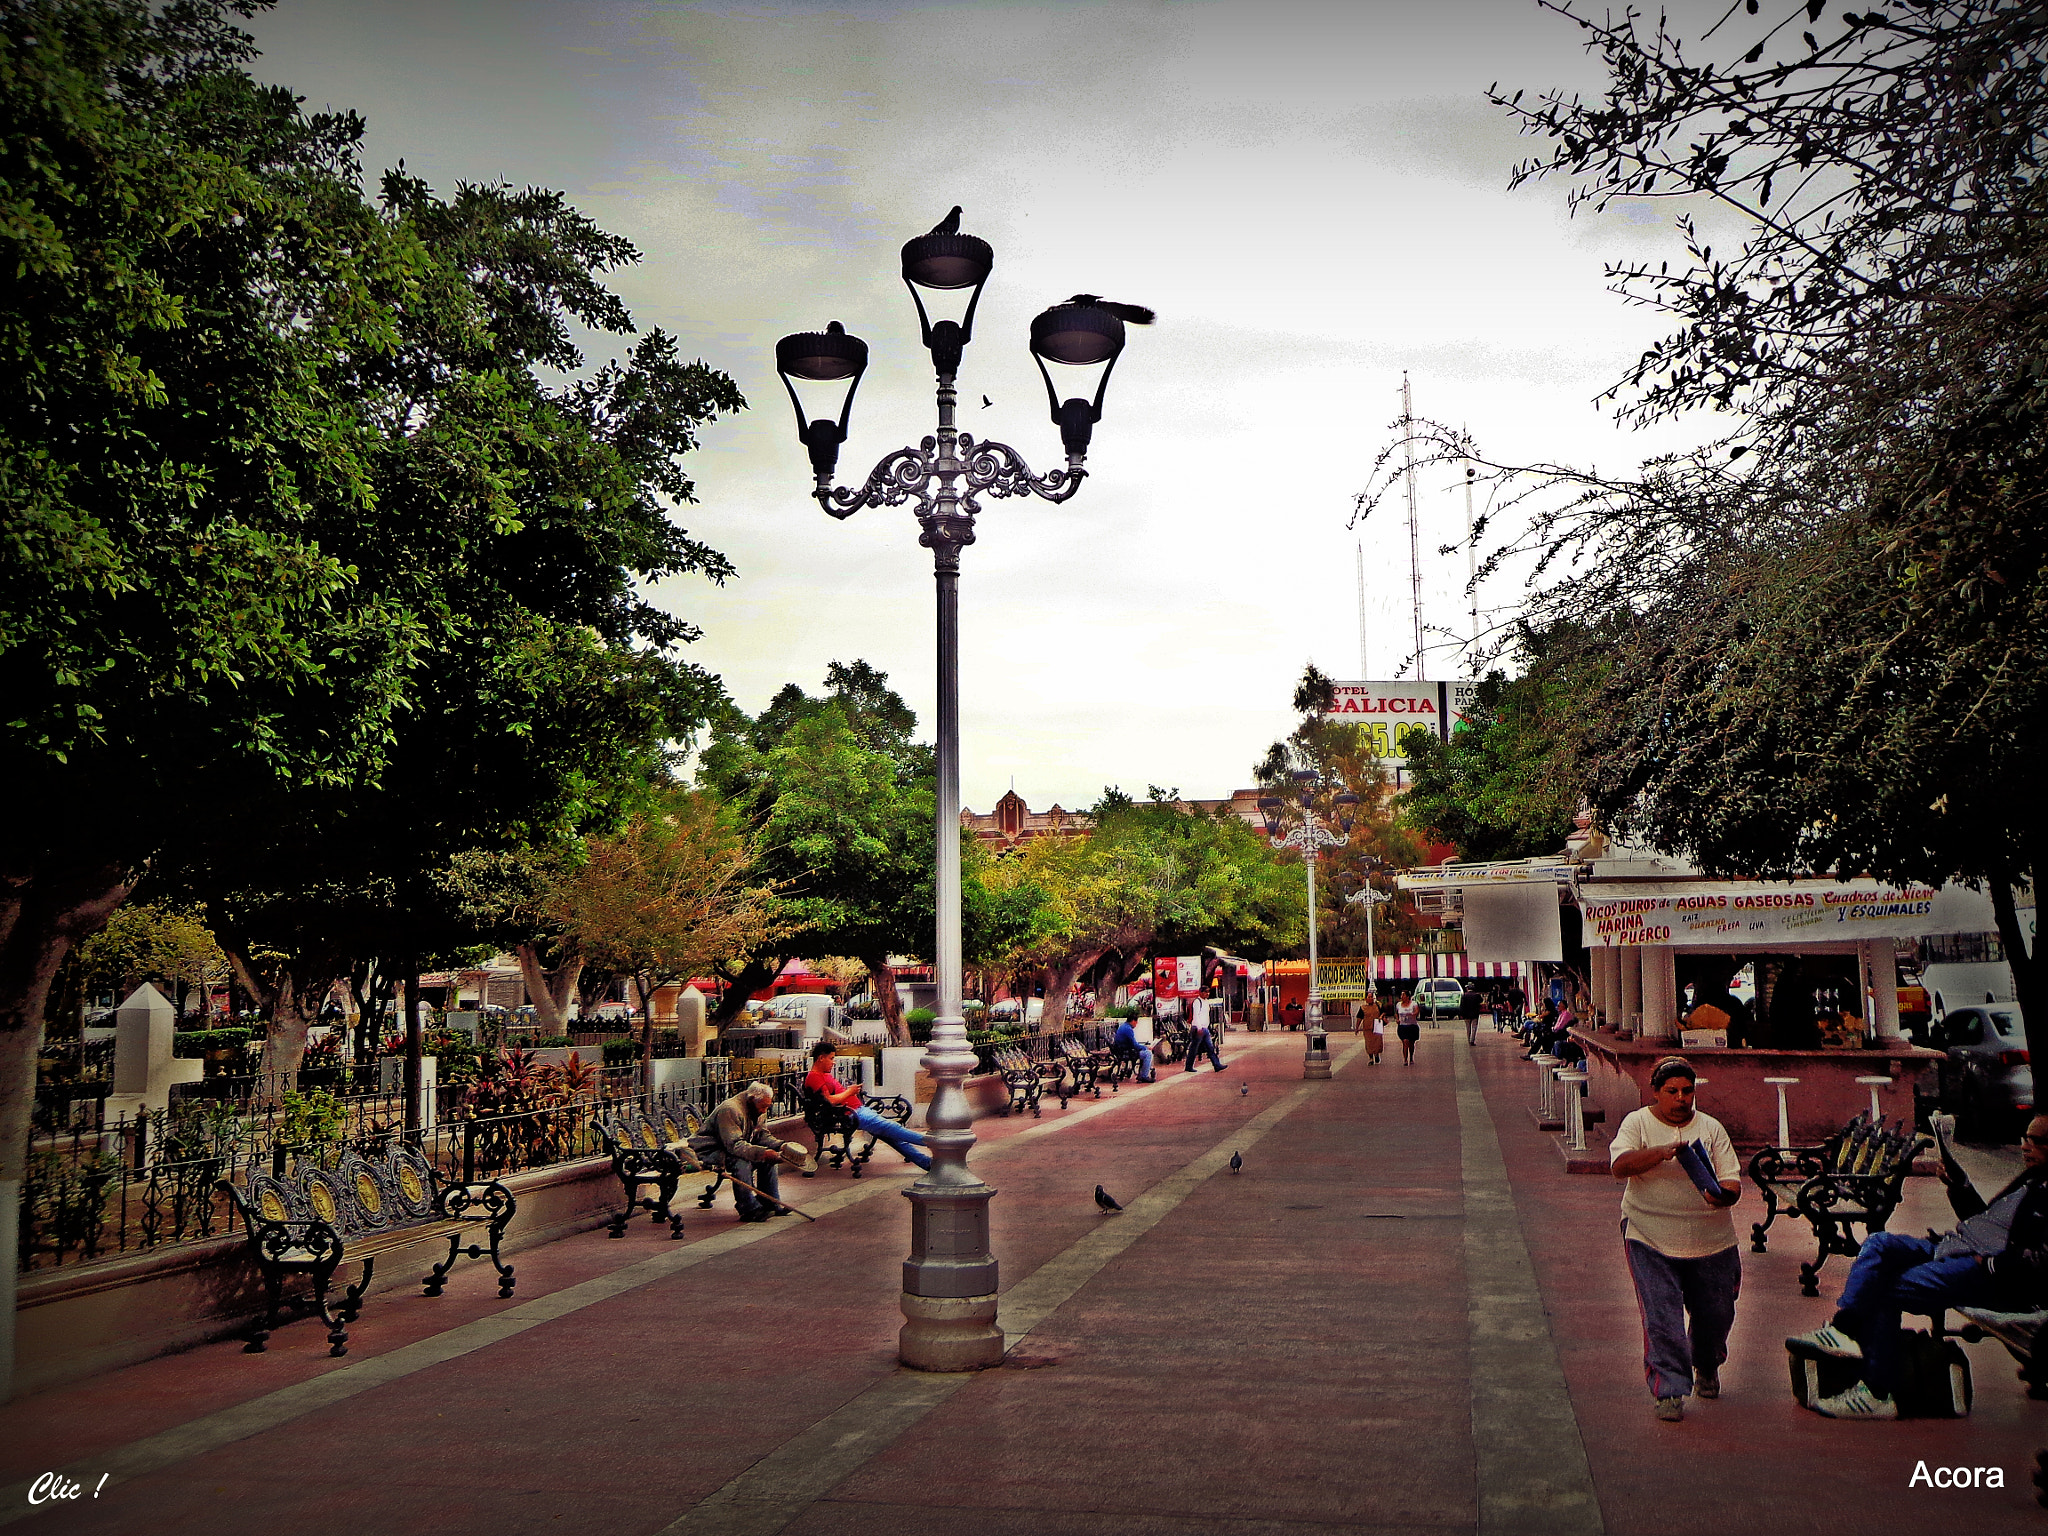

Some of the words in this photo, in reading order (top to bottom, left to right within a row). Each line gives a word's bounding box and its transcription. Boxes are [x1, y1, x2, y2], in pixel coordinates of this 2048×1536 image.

[1331, 687, 1369, 695] OTEL
[1327, 698, 1437, 713] GALICIA
[1823, 890, 1877, 903] Cuadros
[1882, 890, 1895, 901] de
[1897, 883, 1935, 900] Nieve
[1677, 895, 1728, 909] AGUAS
[1734, 893, 1814, 908] GASEOSAS
[1586, 902, 1618, 920] RICOS
[1620, 898, 1657, 914] DUROS
[1659, 898, 1670, 908] de
[1851, 901, 1931, 917] ESQUIMALES
[1597, 914, 1643, 934] HARINA
[1681, 913, 1699, 923] RAIZ
[1689, 918, 1726, 931] DURAZNO
[1749, 920, 1765, 931] UVA
[1619, 925, 1670, 944] PUERCO
[1716, 920, 1741, 935] FRESA
